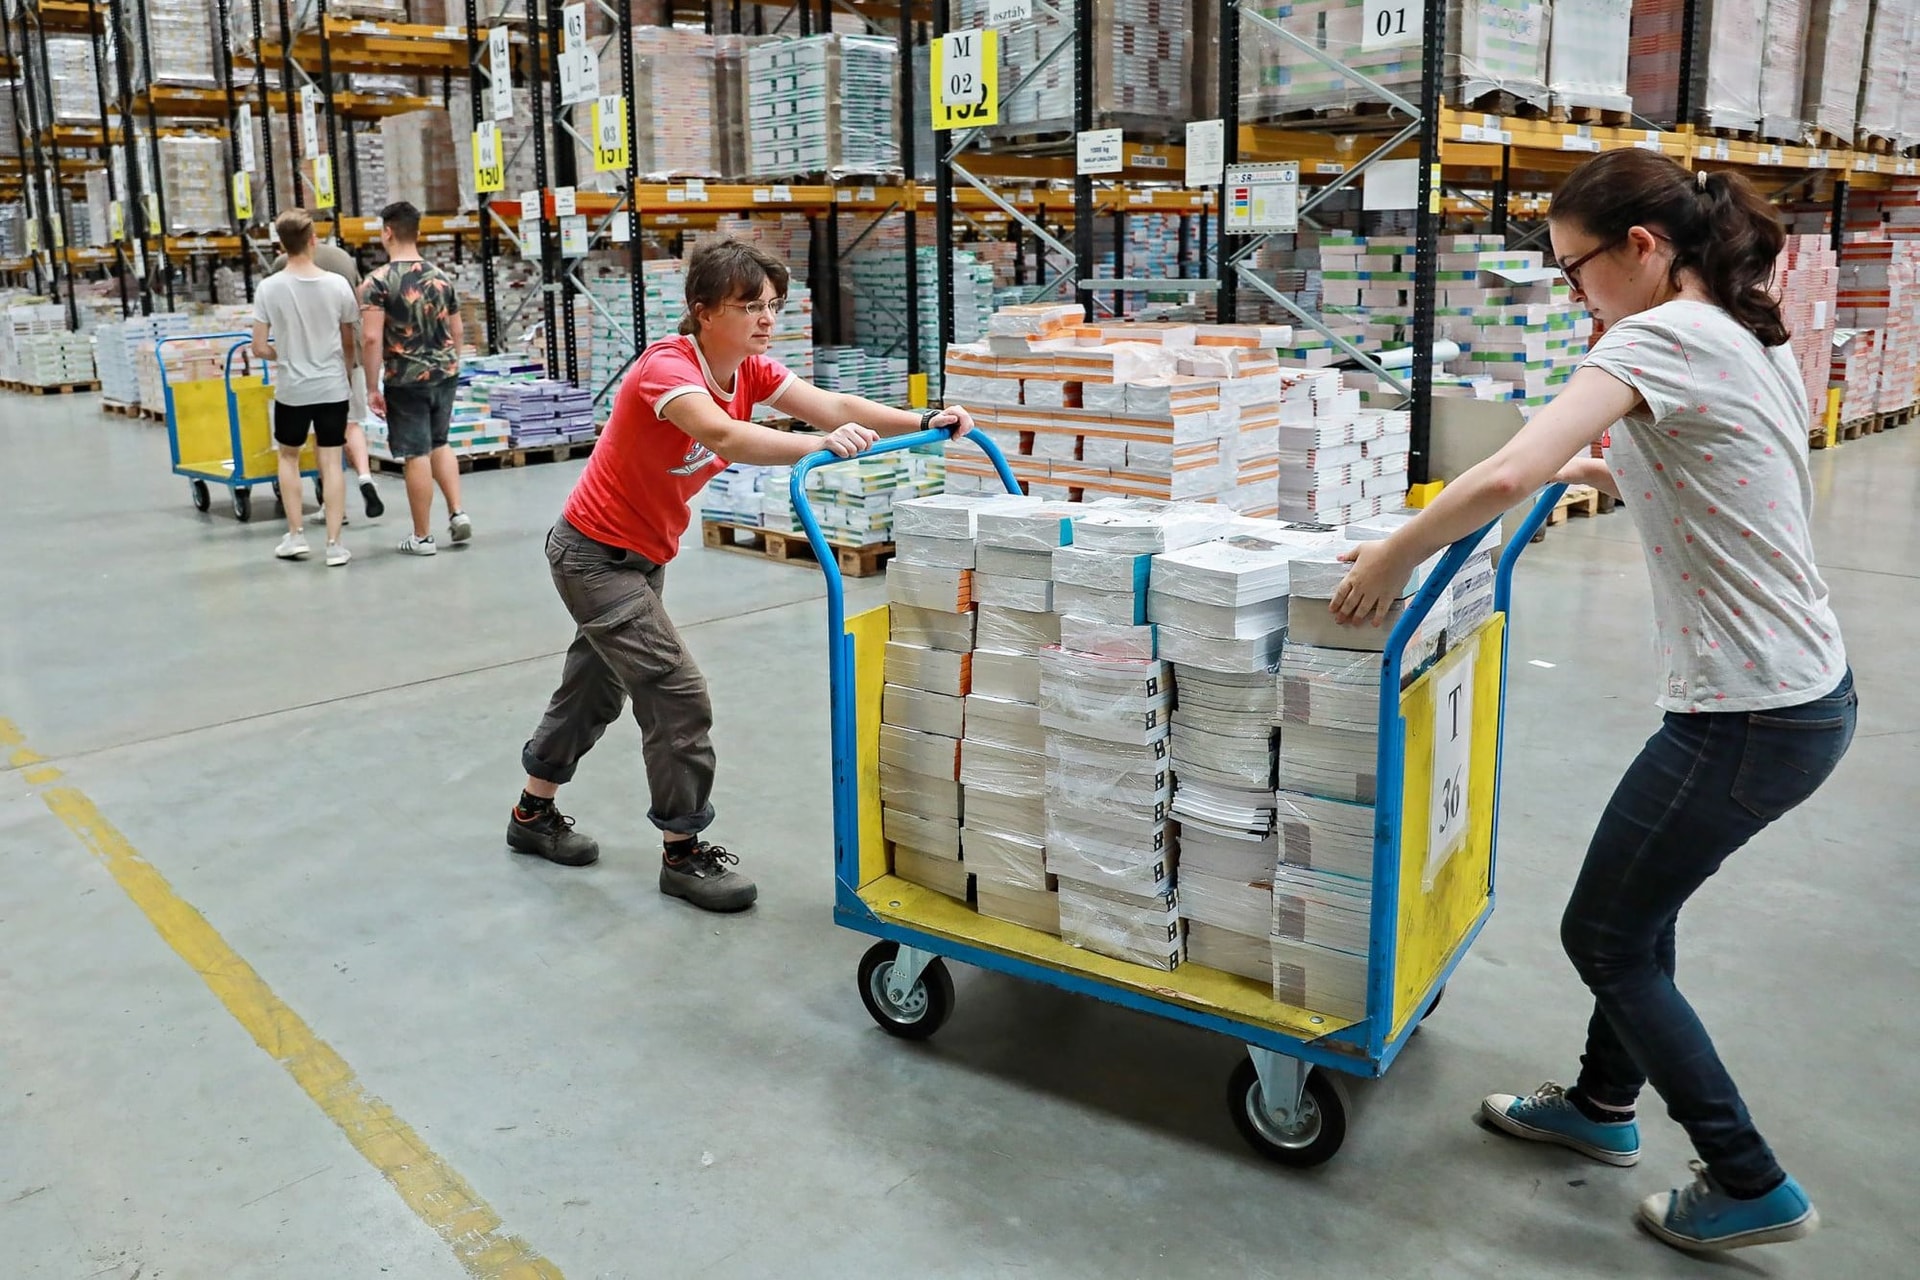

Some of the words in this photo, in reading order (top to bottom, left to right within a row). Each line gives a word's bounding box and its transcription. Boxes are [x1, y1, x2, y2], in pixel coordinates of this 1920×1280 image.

[993, 5, 1026, 21] osztály
[1376, 7, 1407, 37] 01
[568, 14, 582, 37] 03
[493, 38, 506, 60] 04
[952, 35, 972, 59] M
[950, 72, 973, 96] 02
[604, 97, 615, 115] M
[603, 125, 617, 143] 03
[1448, 682, 1462, 743] T
[1438, 763, 1462, 834] 36
